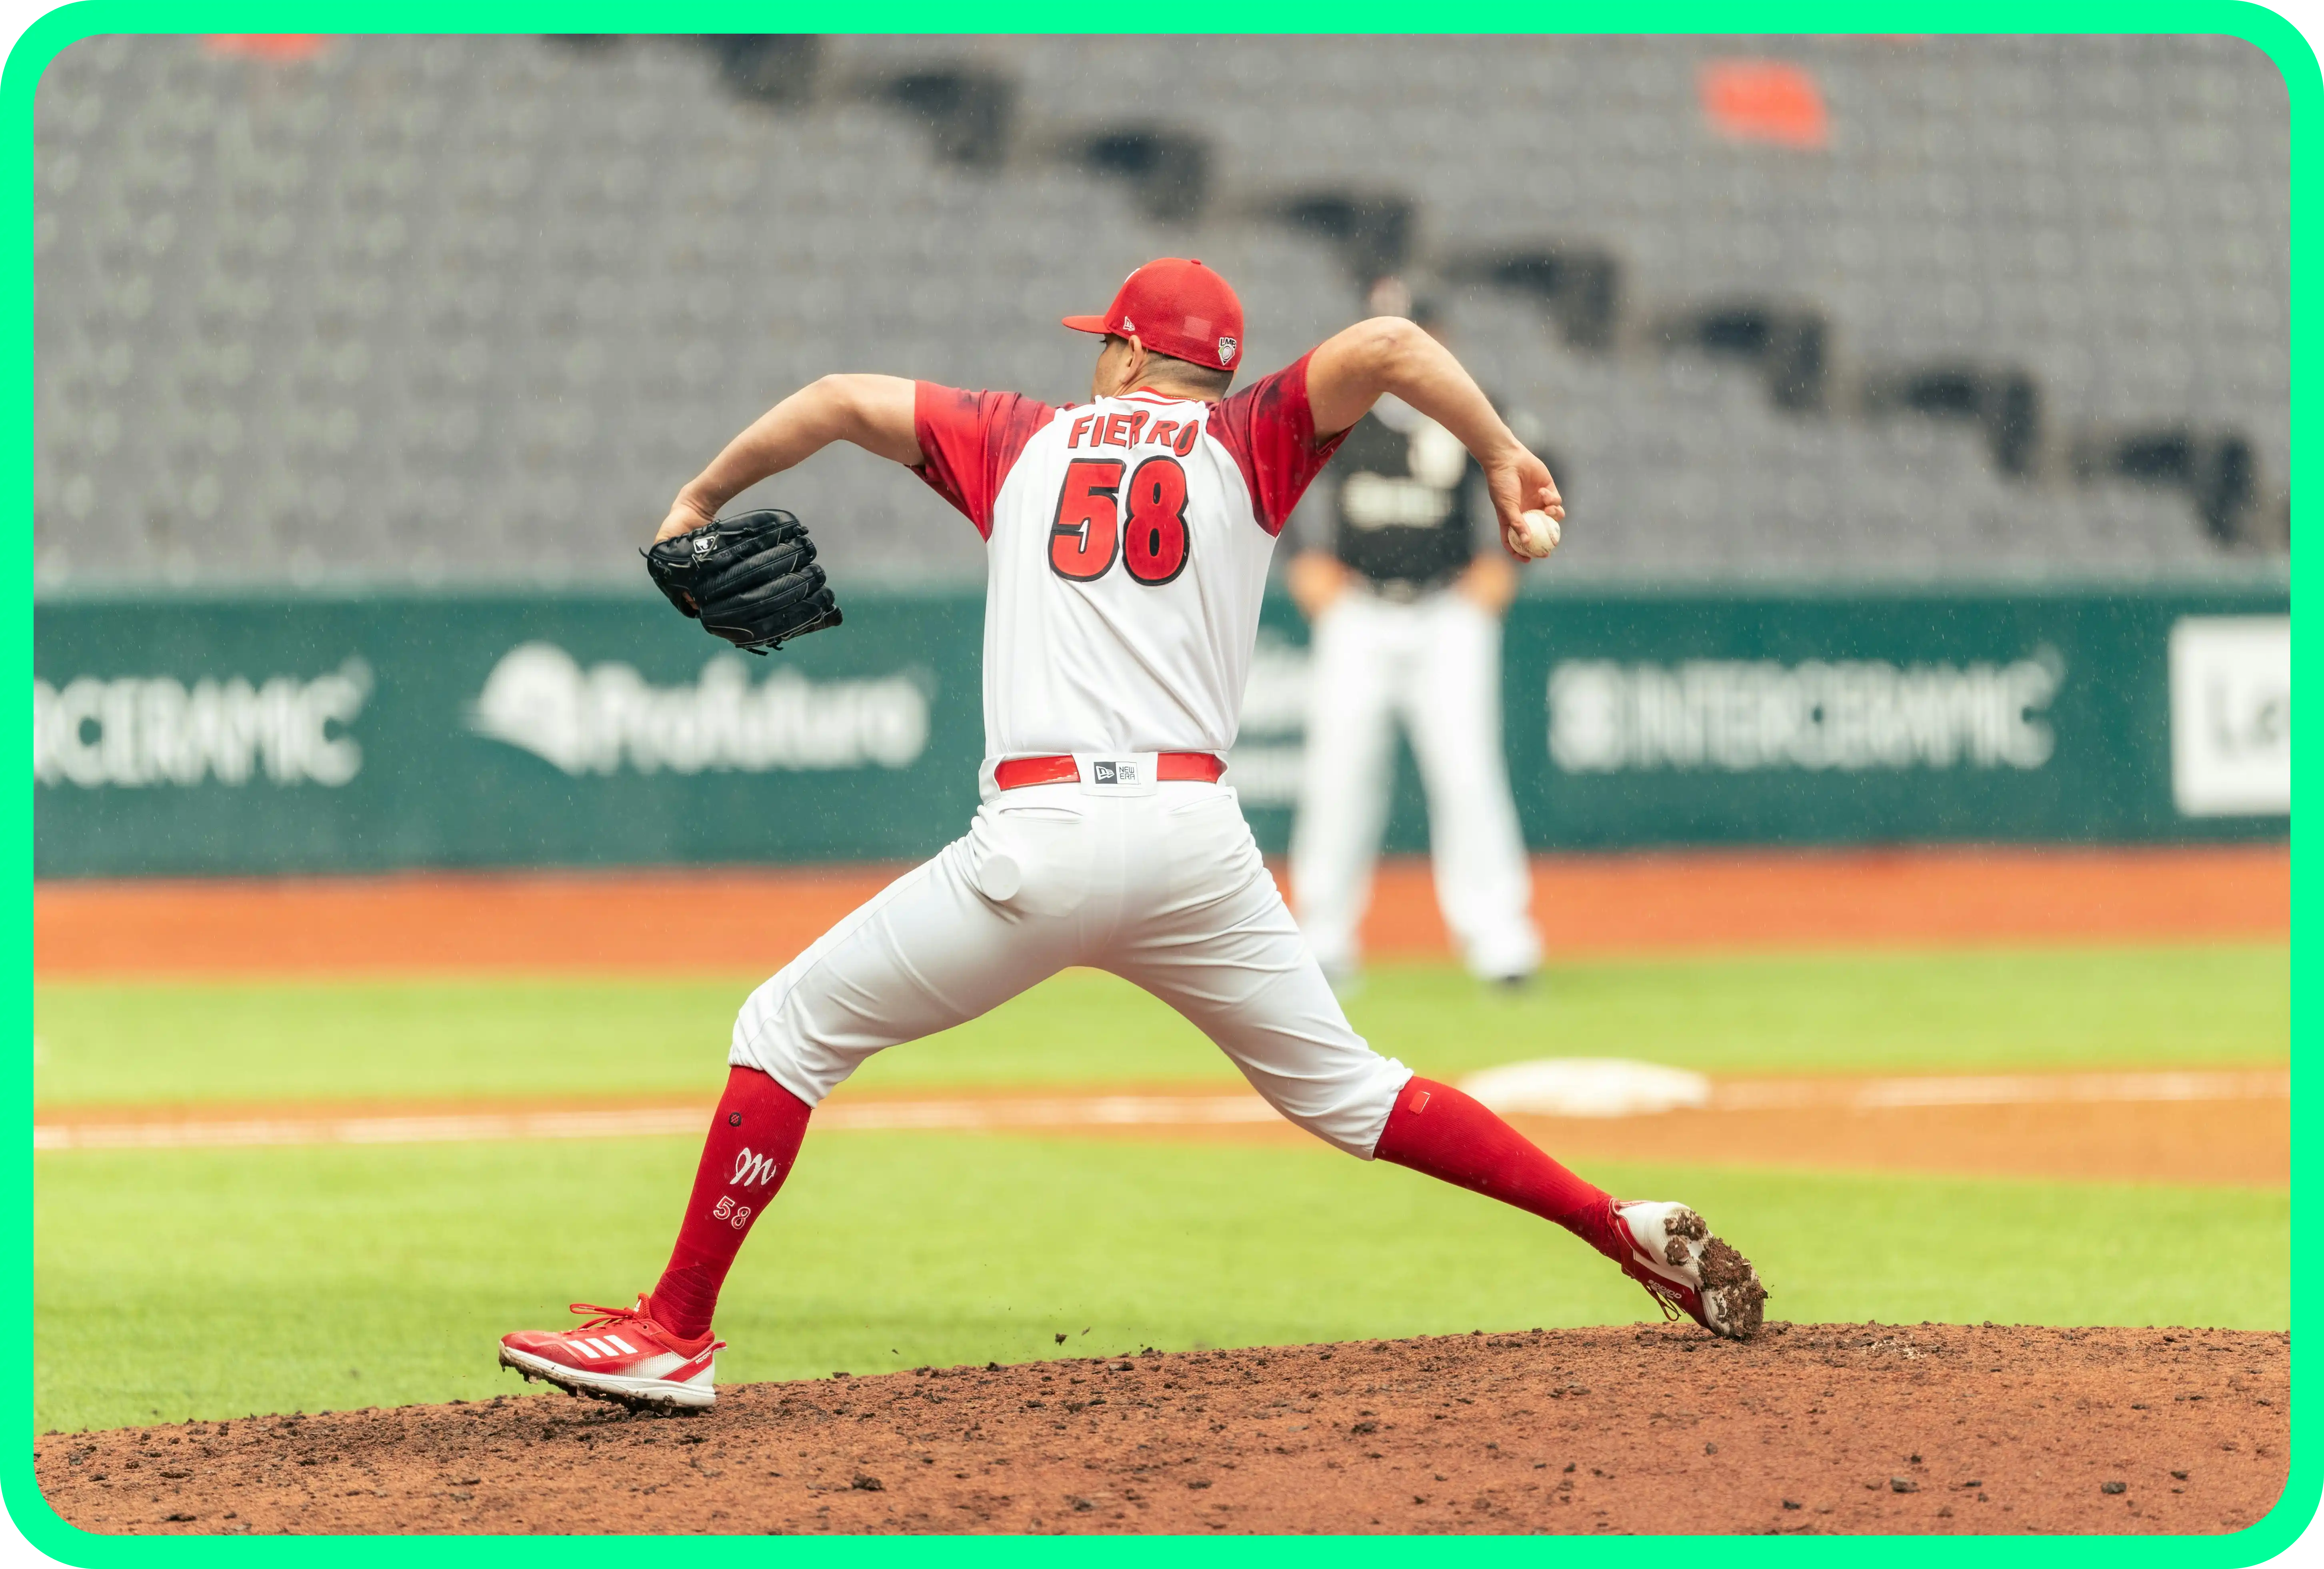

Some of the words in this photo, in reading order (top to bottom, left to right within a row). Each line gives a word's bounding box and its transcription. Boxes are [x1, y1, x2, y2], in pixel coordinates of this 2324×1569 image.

[1219, 338, 1236, 350] LMB
[1068, 410, 1198, 457] FIERRO
[1048, 455, 1190, 586] 58
[713, 1195, 750, 1229] 58
[1647, 1279, 1682, 1299] adidas
[695, 1350, 712, 1365] ICON
